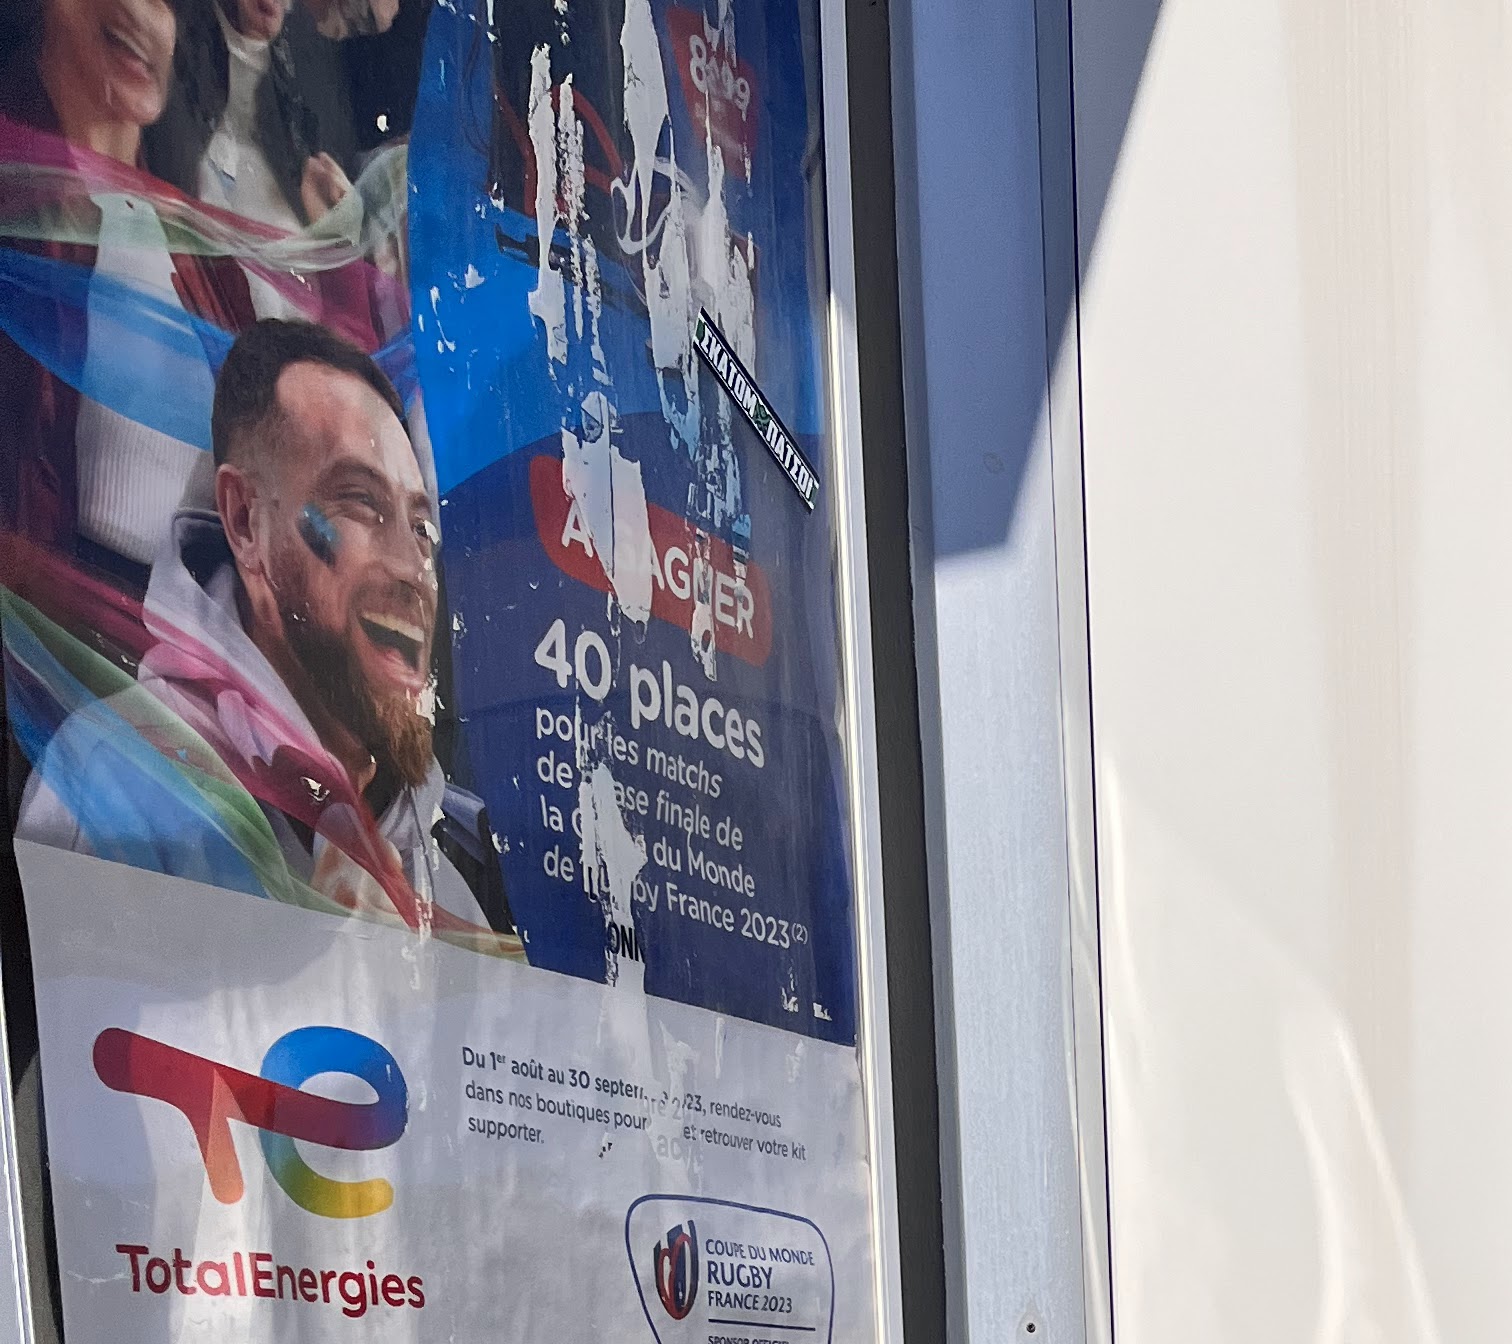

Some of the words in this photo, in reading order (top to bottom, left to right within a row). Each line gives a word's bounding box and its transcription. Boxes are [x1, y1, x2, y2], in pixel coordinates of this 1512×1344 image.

[534, 617, 612, 701] 40
[629, 659, 765, 769] places
[537, 750, 574, 789] de
[656, 788, 711, 839] finale
[716, 816, 743, 851] de
[646, 745, 723, 799] matchs
[540, 794, 565, 833] la
[653, 836, 682, 872] du
[687, 845, 755, 898] Monde
[543, 845, 574, 882] de
[666, 881, 735, 932] France
[740, 908, 790, 950] 2023
[462, 1046, 485, 1069] Du
[511, 1059, 544, 1081] août
[547, 1066, 564, 1085] au
[568, 1068, 591, 1089] 30
[710, 1100, 783, 1128] rendez-vous
[465, 1080, 504, 1104] dans
[508, 1091, 532, 1110] nos
[536, 1092, 610, 1124] boutiques
[614, 1110, 647, 1130] pour
[683, 1124, 697, 1141] et
[700, 1128, 753, 1151] retrouver
[756, 1138, 788, 1158] votre
[791, 1141, 807, 1161] kit
[468, 1115, 546, 1145] supporter.
[115, 1243, 426, 1318] TotalEnergies
[705, 1239, 747, 1260] COUPE
[748, 1244, 767, 1261] DU
[768, 1247, 815, 1266] MONDE
[707, 1260, 772, 1290] RUGBY
[707, 1290, 759, 1311] FRANCE
[760, 1295, 793, 1314] 2023
